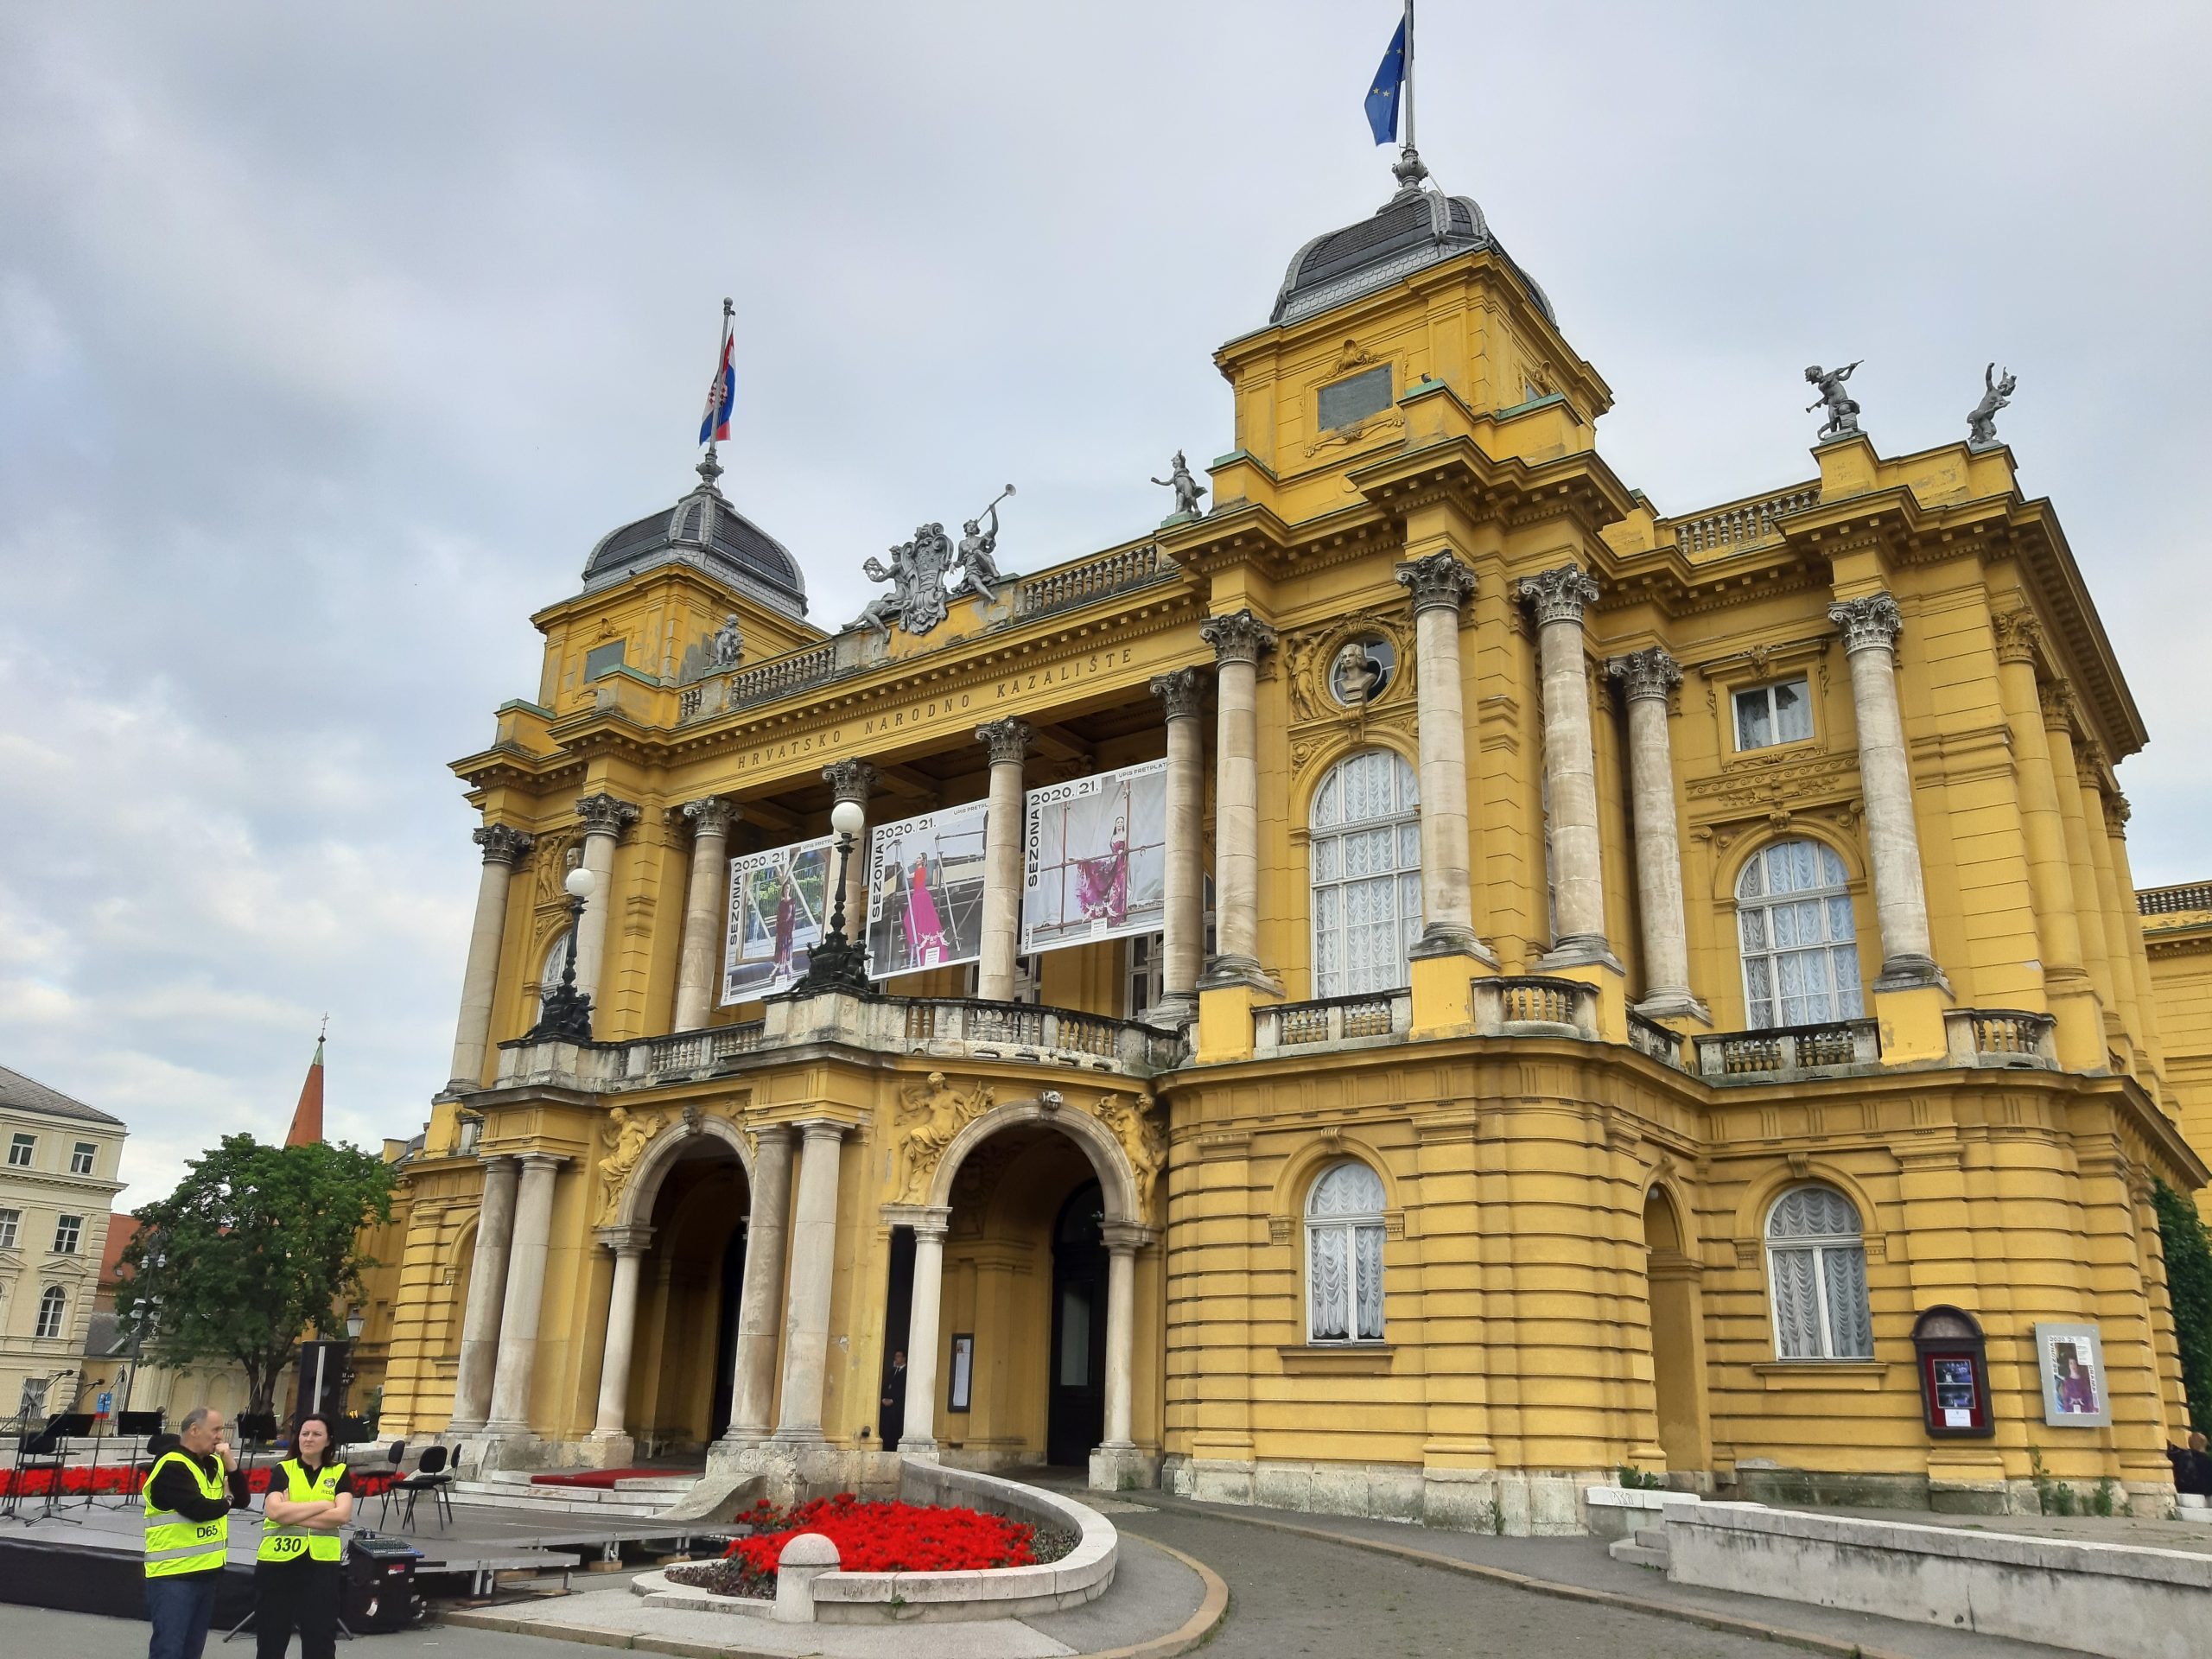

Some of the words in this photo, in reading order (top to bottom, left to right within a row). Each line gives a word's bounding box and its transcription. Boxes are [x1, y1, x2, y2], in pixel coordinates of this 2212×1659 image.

[737, 730, 841, 769] HRVATSKO
[865, 695, 969, 734] NARODNO
[996, 648, 1132, 698] KAZALIŠTE
[872, 843, 885, 918] SEZONA
[1028, 808, 1040, 887] SEZONA
[730, 874, 741, 946] SEZONA
[196, 1525, 219, 1538] D65
[273, 1537, 302, 1553] 330
